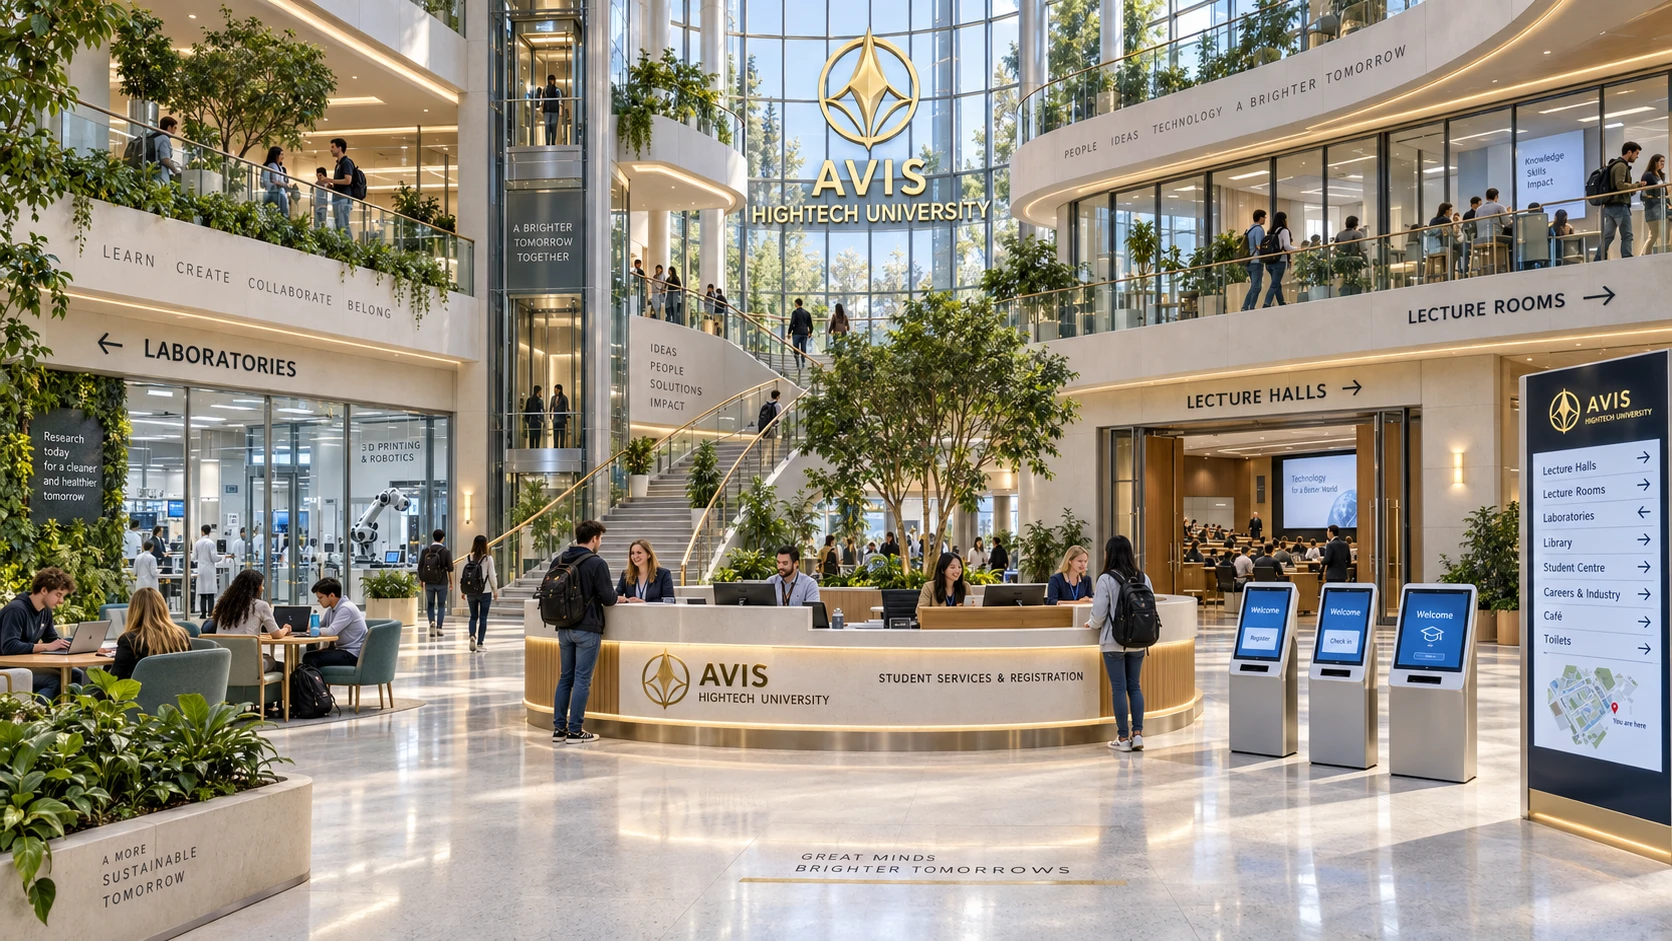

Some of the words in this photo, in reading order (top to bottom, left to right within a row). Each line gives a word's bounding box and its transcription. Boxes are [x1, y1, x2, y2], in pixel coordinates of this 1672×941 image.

[1065, 142, 1096, 158] PEOPLE
[1112, 130, 1138, 145] IDEAS
[1153, 106, 1222, 134] TECHNOLOGY
[1236, 102, 1242, 111] A
[1251, 79, 1315, 107] BRIGHTER
[1326, 45, 1406, 83] TOMORROW
[1525, 153, 1564, 165] Knowledge
[812, 158, 926, 197] AVIS
[1527, 168, 1546, 177] Skills
[1528, 178, 1553, 189] Impact
[752, 204, 859, 225] HIGHTECH
[866, 199, 991, 223] UNIVERSITY
[524, 223, 572, 232] BRIGHTER
[514, 238, 573, 246] TOMORROW
[517, 252, 569, 262] TOGETHER
[104, 245, 154, 267] LEARN
[177, 262, 229, 283] CREATE
[248, 278, 331, 305] COLLABORATE
[348, 300, 390, 318] BELONG
[1409, 302, 1485, 324] LECTURE
[1495, 293, 1565, 314] ROOMS
[651, 344, 676, 356] IDEAS
[145, 339, 296, 377] LABORATORIES
[651, 362, 683, 376] PEOPLE
[650, 379, 702, 396] SOLUTIONS
[1188, 390, 1261, 408] LECTURE
[1270, 384, 1326, 402] HALLS
[1587, 390, 1630, 413] AVIS
[651, 398, 684, 410] IMPACT
[1616, 409, 1652, 420] UNIVERSITY
[44, 432, 84, 443] Research
[378, 441, 420, 450] PRINTING
[44, 447, 69, 459] today
[370, 453, 414, 462] ROBOTICS
[44, 460, 56, 470] for
[67, 462, 97, 473] cleaner
[1543, 466, 1572, 476] Lecture
[1576, 461, 1596, 472] Halls
[44, 476, 59, 486] and
[62, 477, 97, 487] healthier
[1292, 474, 1326, 483] Technology
[44, 492, 84, 501] tomorrow
[1544, 490, 1573, 498] Lecture
[1576, 487, 1605, 496] Rooms
[1544, 511, 1594, 522] Laboratories
[1544, 538, 1572, 550] Library
[1544, 563, 1574, 572] Student
[1578, 563, 1605, 572] Centre
[1544, 588, 1574, 598] Careers
[1577, 588, 1583, 598] &
[1586, 589, 1620, 602] Industry
[1417, 611, 1453, 619] Welcome
[1544, 611, 1562, 621] Café
[1544, 634, 1571, 645] Toilets
[700, 664, 768, 687] AVIS
[879, 674, 932, 683] STUDENT
[938, 674, 991, 683] SERVICES
[998, 673, 1004, 682] &
[1011, 672, 1083, 682] REGISTRATION
[699, 692, 754, 703] HIGHTECH
[762, 694, 829, 705] UNIVERSITY
[102, 856, 109, 865] A
[115, 844, 146, 862] MORE
[102, 846, 197, 886] SUSTAINABLE
[796, 865, 899, 873] BRIGHTER
[102, 870, 185, 908] TOMORROW
